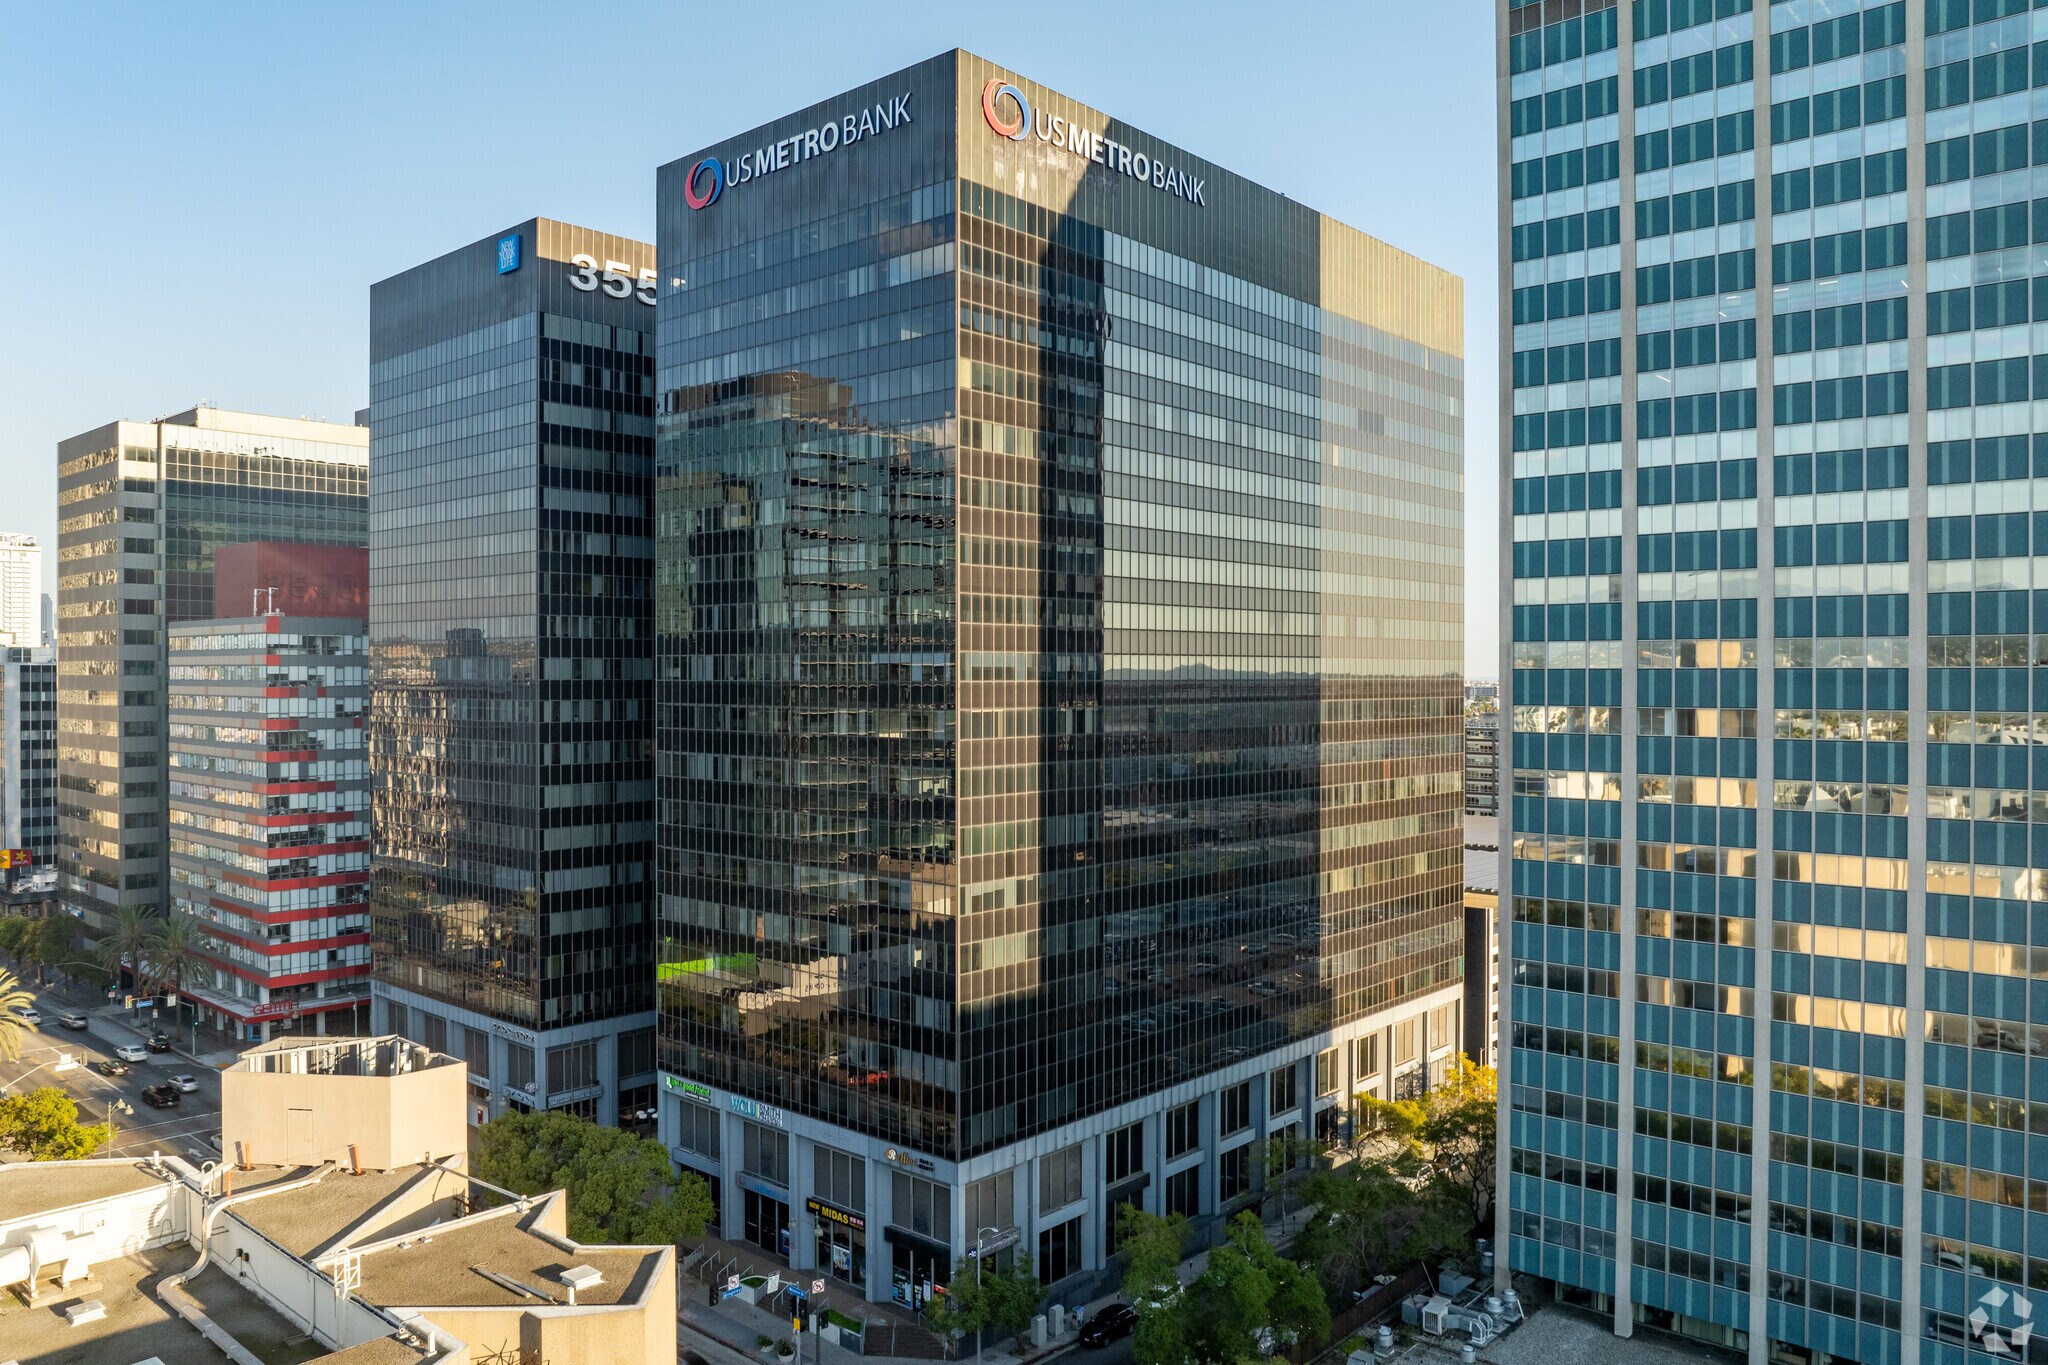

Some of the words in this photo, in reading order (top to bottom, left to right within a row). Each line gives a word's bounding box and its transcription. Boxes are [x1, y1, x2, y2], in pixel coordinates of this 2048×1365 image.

[755, 121, 839, 178] METRO
[843, 92, 912, 146] BANK
[1068, 122, 1151, 182] METRO
[1153, 160, 1205, 207] BANK
[498, 246, 515, 261] YORK
[501, 238, 515, 251] NEW
[501, 255, 514, 269] LIFE
[731, 1095, 756, 1117] WCU
[809, 1201, 820, 1211] NEW
[821, 1206, 849, 1225] MIDAS
